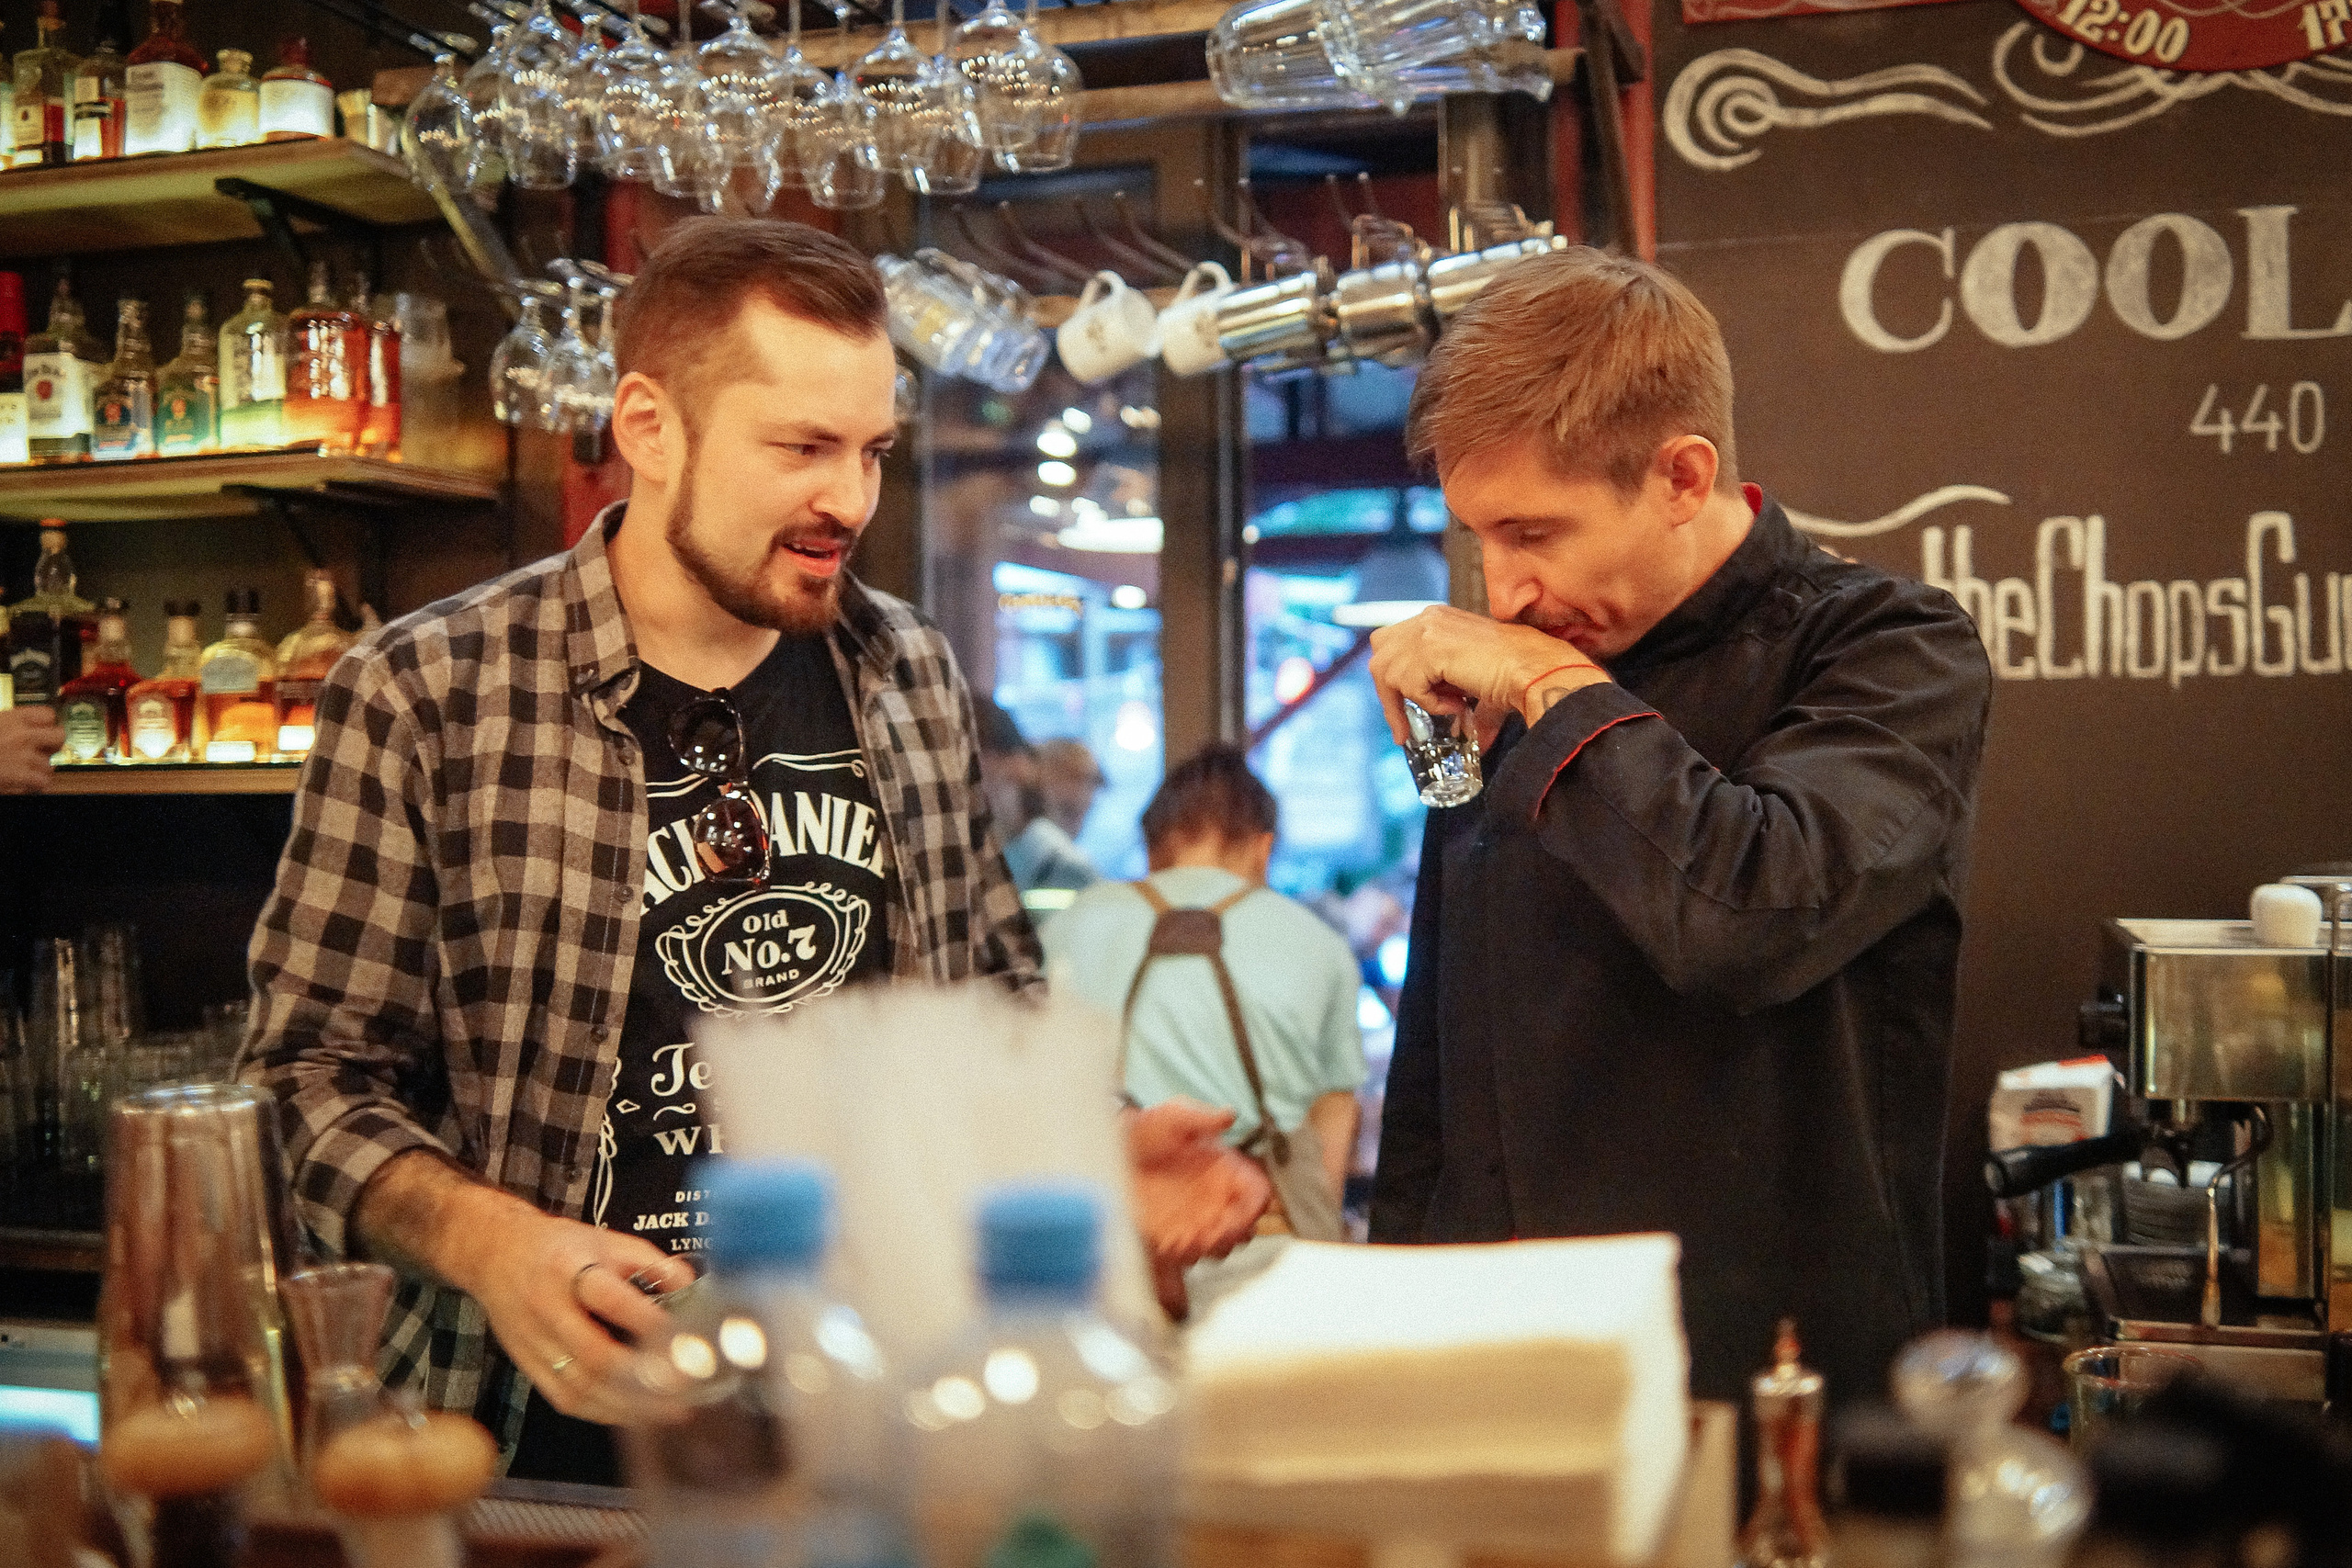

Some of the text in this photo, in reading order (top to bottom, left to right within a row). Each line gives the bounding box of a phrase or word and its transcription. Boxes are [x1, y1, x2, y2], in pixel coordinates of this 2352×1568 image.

[2054, 0, 2190, 63] 12:00
[1838, 205, 2352, 353] COOL
[2190, 380, 2326, 455] 440
[1922, 511, 2352, 690] heChopsGu
[742, 909, 789, 934] Old
[742, 968, 800, 990] BRAND
[632, 1212, 690, 1231] JACK
